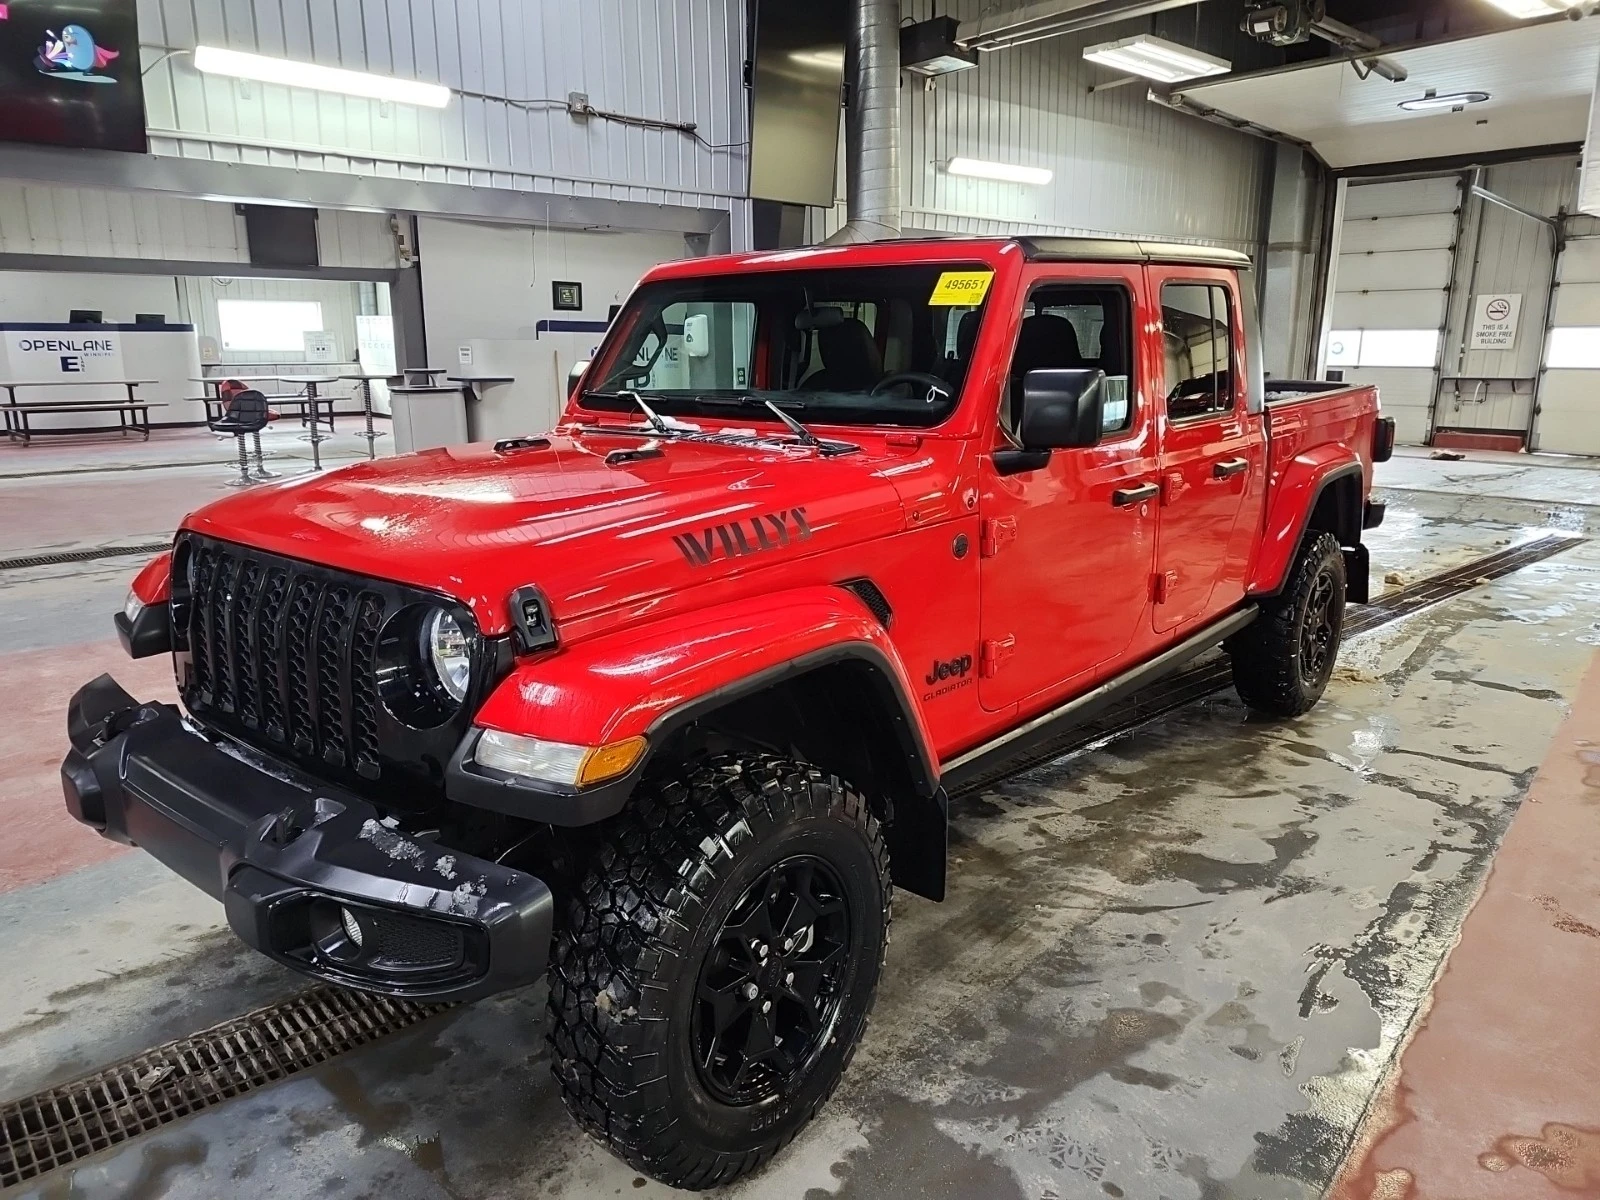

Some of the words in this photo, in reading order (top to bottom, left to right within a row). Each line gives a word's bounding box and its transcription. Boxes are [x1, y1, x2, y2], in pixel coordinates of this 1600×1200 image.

[944, 279, 986, 290] 495651
[19, 339, 113, 351] OPENLANE
[671, 506, 813, 569] WILLYS
[925, 654, 973, 686] Jeep
[923, 678, 973, 702] GLADIATOR
